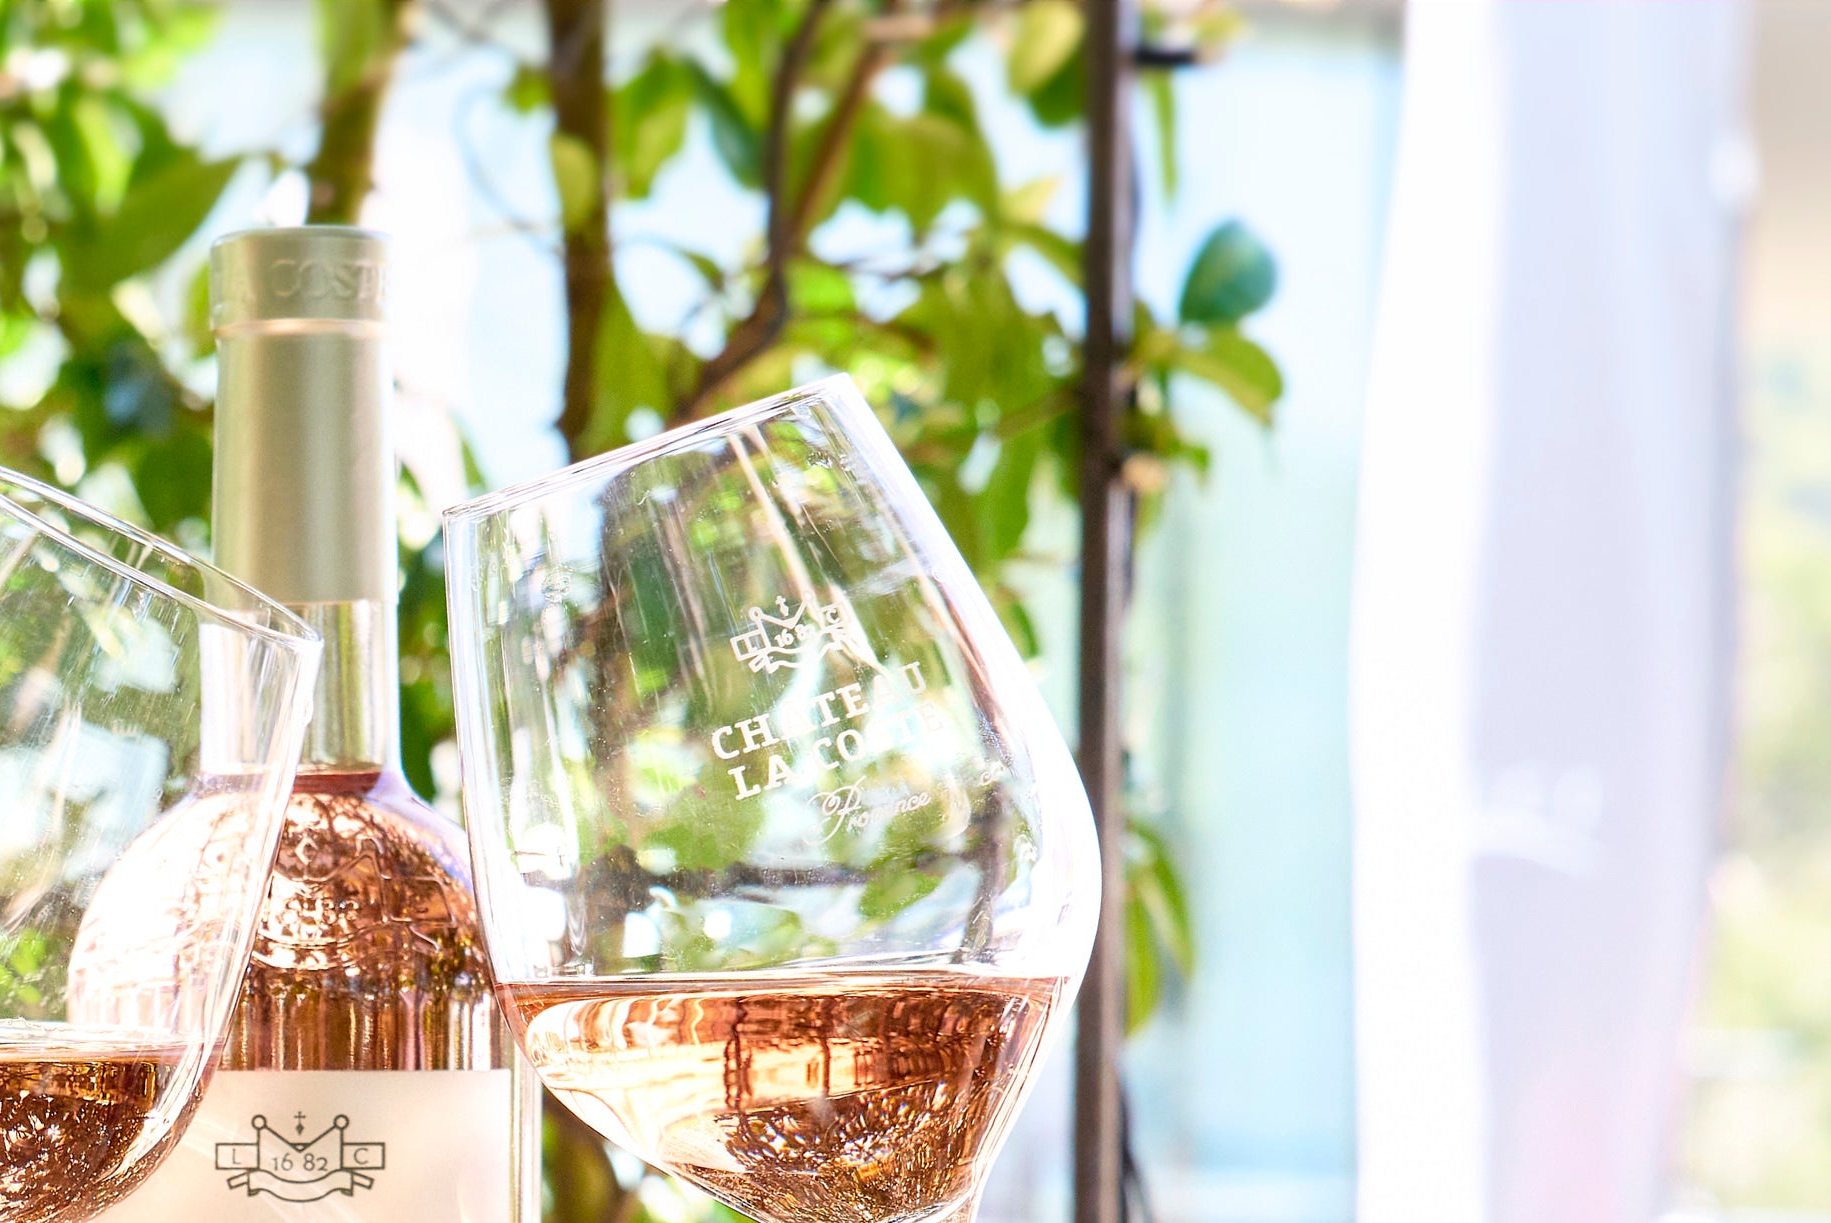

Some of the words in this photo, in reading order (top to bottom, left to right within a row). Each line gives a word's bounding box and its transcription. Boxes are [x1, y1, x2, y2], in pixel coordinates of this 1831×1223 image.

[811, 702, 944, 771] COTE
[232, 1148, 242, 1165] L
[353, 1147, 370, 1165] C
